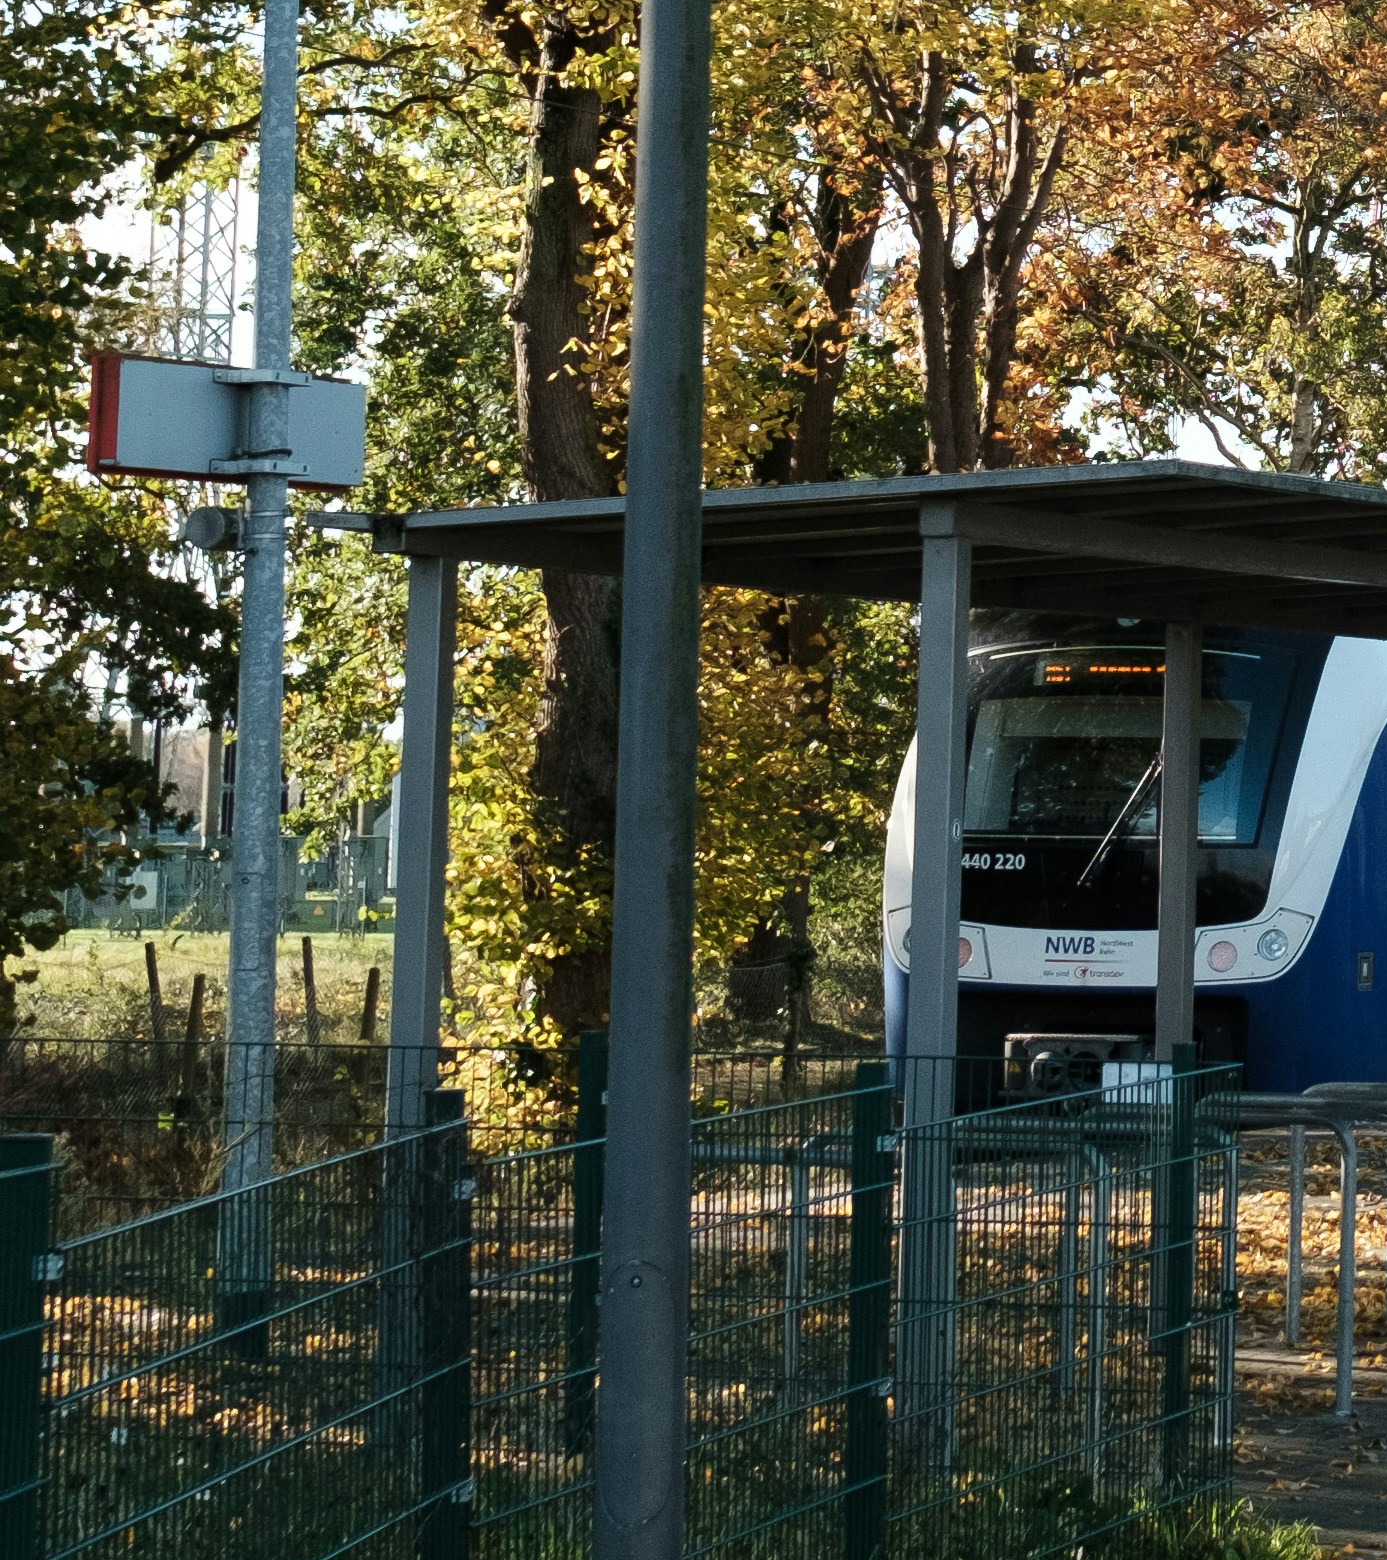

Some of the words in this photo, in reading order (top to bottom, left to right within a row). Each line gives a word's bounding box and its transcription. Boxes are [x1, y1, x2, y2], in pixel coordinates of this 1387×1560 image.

[961, 853, 991, 870] 440
[994, 853, 1026, 870] 220
[1045, 936, 1095, 955] NWB
